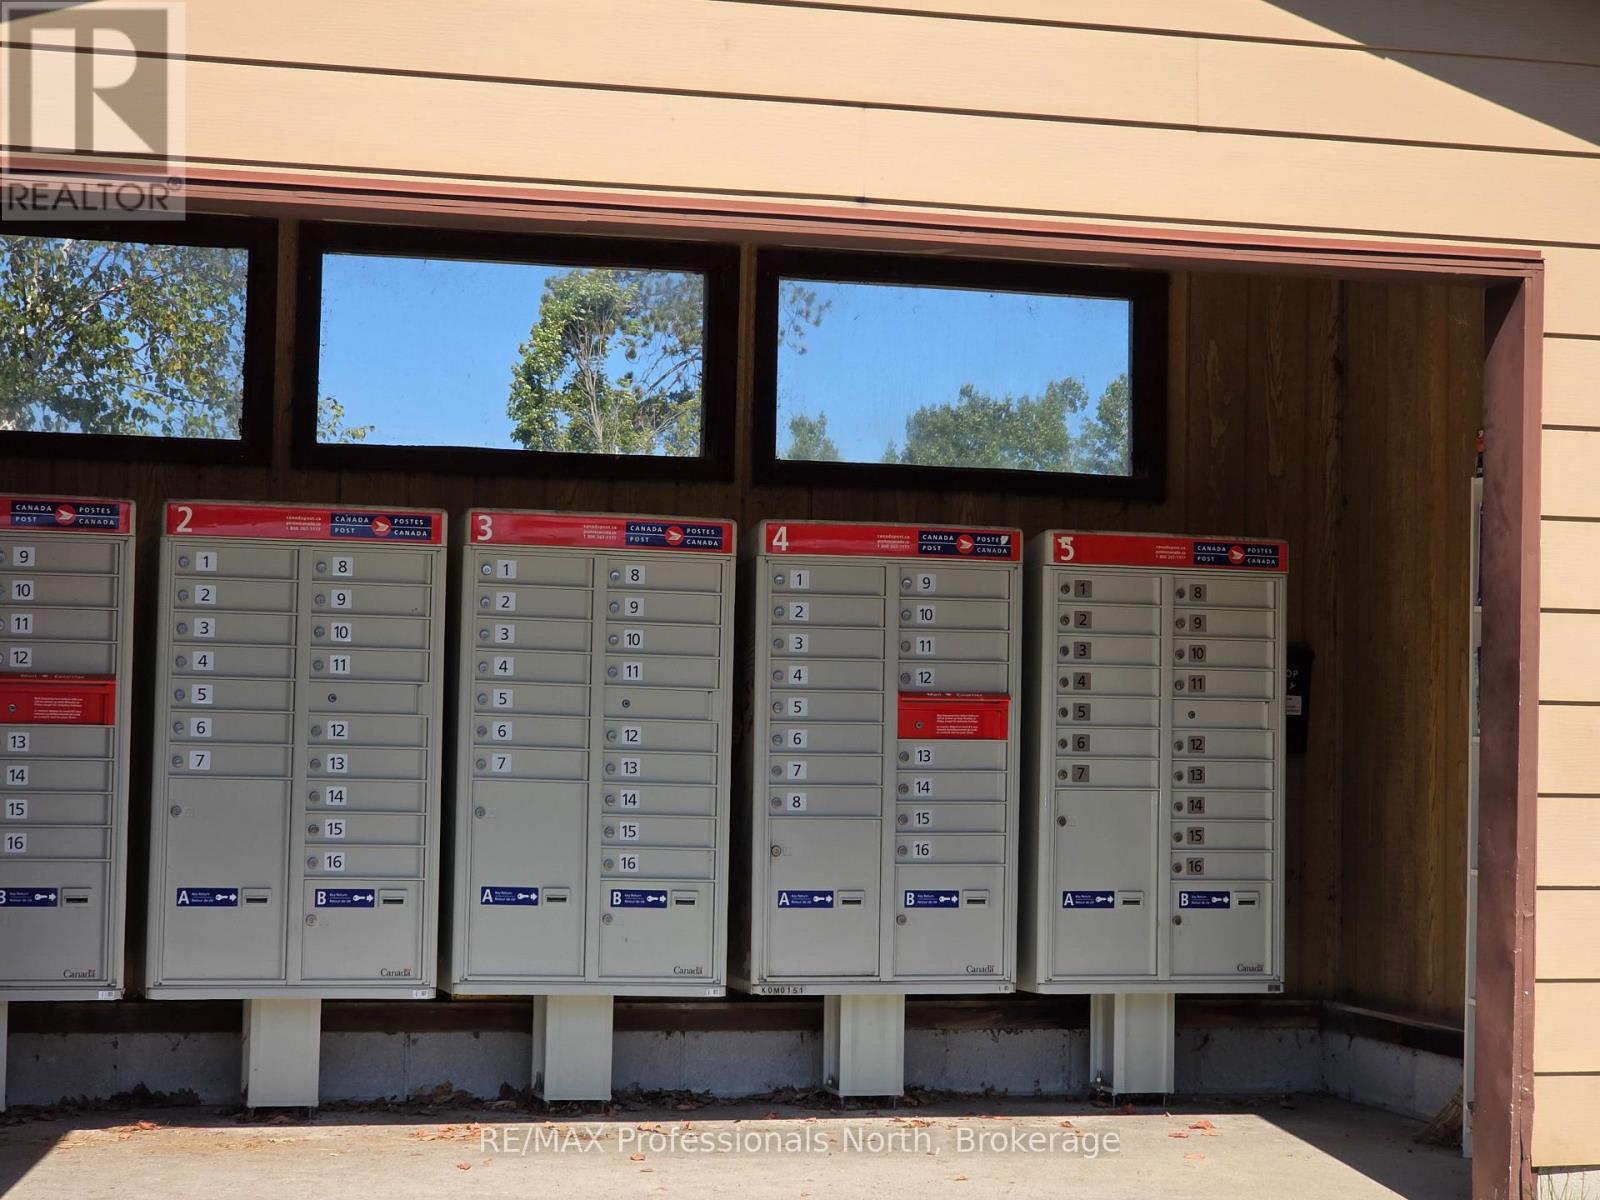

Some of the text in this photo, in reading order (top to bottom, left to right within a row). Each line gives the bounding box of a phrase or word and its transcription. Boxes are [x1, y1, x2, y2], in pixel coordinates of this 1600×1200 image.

[15, 504, 52, 512] CANADA
[78, 518, 115, 526] CANADA
[176, 506, 193, 533] 2
[335, 515, 369, 524] CANADA
[394, 518, 424, 526] POSTES
[394, 529, 427, 537] CANADA
[477, 514, 493, 541] 3
[630, 525, 663, 533] CANADA
[772, 526, 789, 552] 4
[19, 549, 29, 564] 9
[202, 555, 209, 569] 1
[337, 559, 348, 574] 8
[503, 563, 509, 577] 1
[630, 568, 640, 582] 8
[796, 572, 802, 587] 1
[922, 576, 932, 590] 9
[1079, 582, 1086, 596] 1
[15, 583, 31, 598] 10
[200, 587, 211, 602] 2
[1193, 586, 1203, 600] 8
[336, 592, 346, 606] 9
[501, 595, 510, 609] 2
[629, 600, 639, 614] 9
[794, 604, 804, 619] 2
[919, 607, 934, 622] 10
[1078, 613, 1088, 627] 2
[14, 616, 29, 631] 11
[199, 620, 210, 635] 3
[1193, 616, 1203, 630] 9
[333, 625, 349, 640] 10
[500, 627, 510, 641] 3
[626, 632, 641, 647] 10
[794, 636, 804, 650] 3
[919, 639, 932, 653] 11
[1078, 643, 1087, 657] 3
[13, 650, 29, 665] 12
[1191, 647, 1205, 660] 10
[197, 654, 208, 668] 4
[333, 658, 346, 672] 11
[498, 659, 509, 673] 4
[626, 664, 639, 679] 11
[792, 668, 803, 682] 4
[918, 670, 932, 685] 12
[1077, 674, 1086, 688] 4
[1190, 677, 1203, 690] 11
[197, 687, 207, 702] 5
[498, 692, 508, 706] 5
[793, 700, 802, 714] 5
[1077, 705, 1086, 719] 5
[195, 720, 206, 735] 6
[330, 723, 345, 738] 12
[497, 724, 507, 738] 6
[10, 735, 27, 749] 13
[624, 728, 639, 743] 12
[792, 731, 802, 746] 6
[1076, 736, 1086, 750] 6
[1190, 737, 1203, 751] 12
[195, 753, 206, 768] 7
[497, 756, 507, 770] 7
[917, 749, 932, 763] 13
[329, 756, 345, 771] 13
[623, 761, 638, 775] 13
[792, 763, 802, 777] 7
[9, 768, 26, 783] 14
[1076, 766, 1086, 781] 7
[1189, 768, 1203, 782] 13
[915, 780, 931, 794] 14
[328, 789, 344, 803] 14
[622, 792, 637, 806] 14
[791, 795, 802, 809] 8
[8, 802, 25, 817] 15
[1189, 799, 1203, 812] 14
[915, 811, 930, 825] 15
[327, 822, 343, 836] 15
[621, 824, 637, 838] 15
[1189, 829, 1203, 842] 15
[6, 835, 24, 850] 16
[914, 843, 930, 857] 16
[326, 855, 343, 869] 16
[620, 856, 637, 870] 16
[1188, 859, 1203, 873] 16
[178, 890, 190, 904] A
[317, 891, 327, 905] B
[482, 889, 493, 903] A
[613, 891, 622, 905] B
[778, 892, 790, 906] A
[906, 892, 915, 906] B
[1063, 893, 1074, 906] A
[1181, 893, 1189, 906] B
